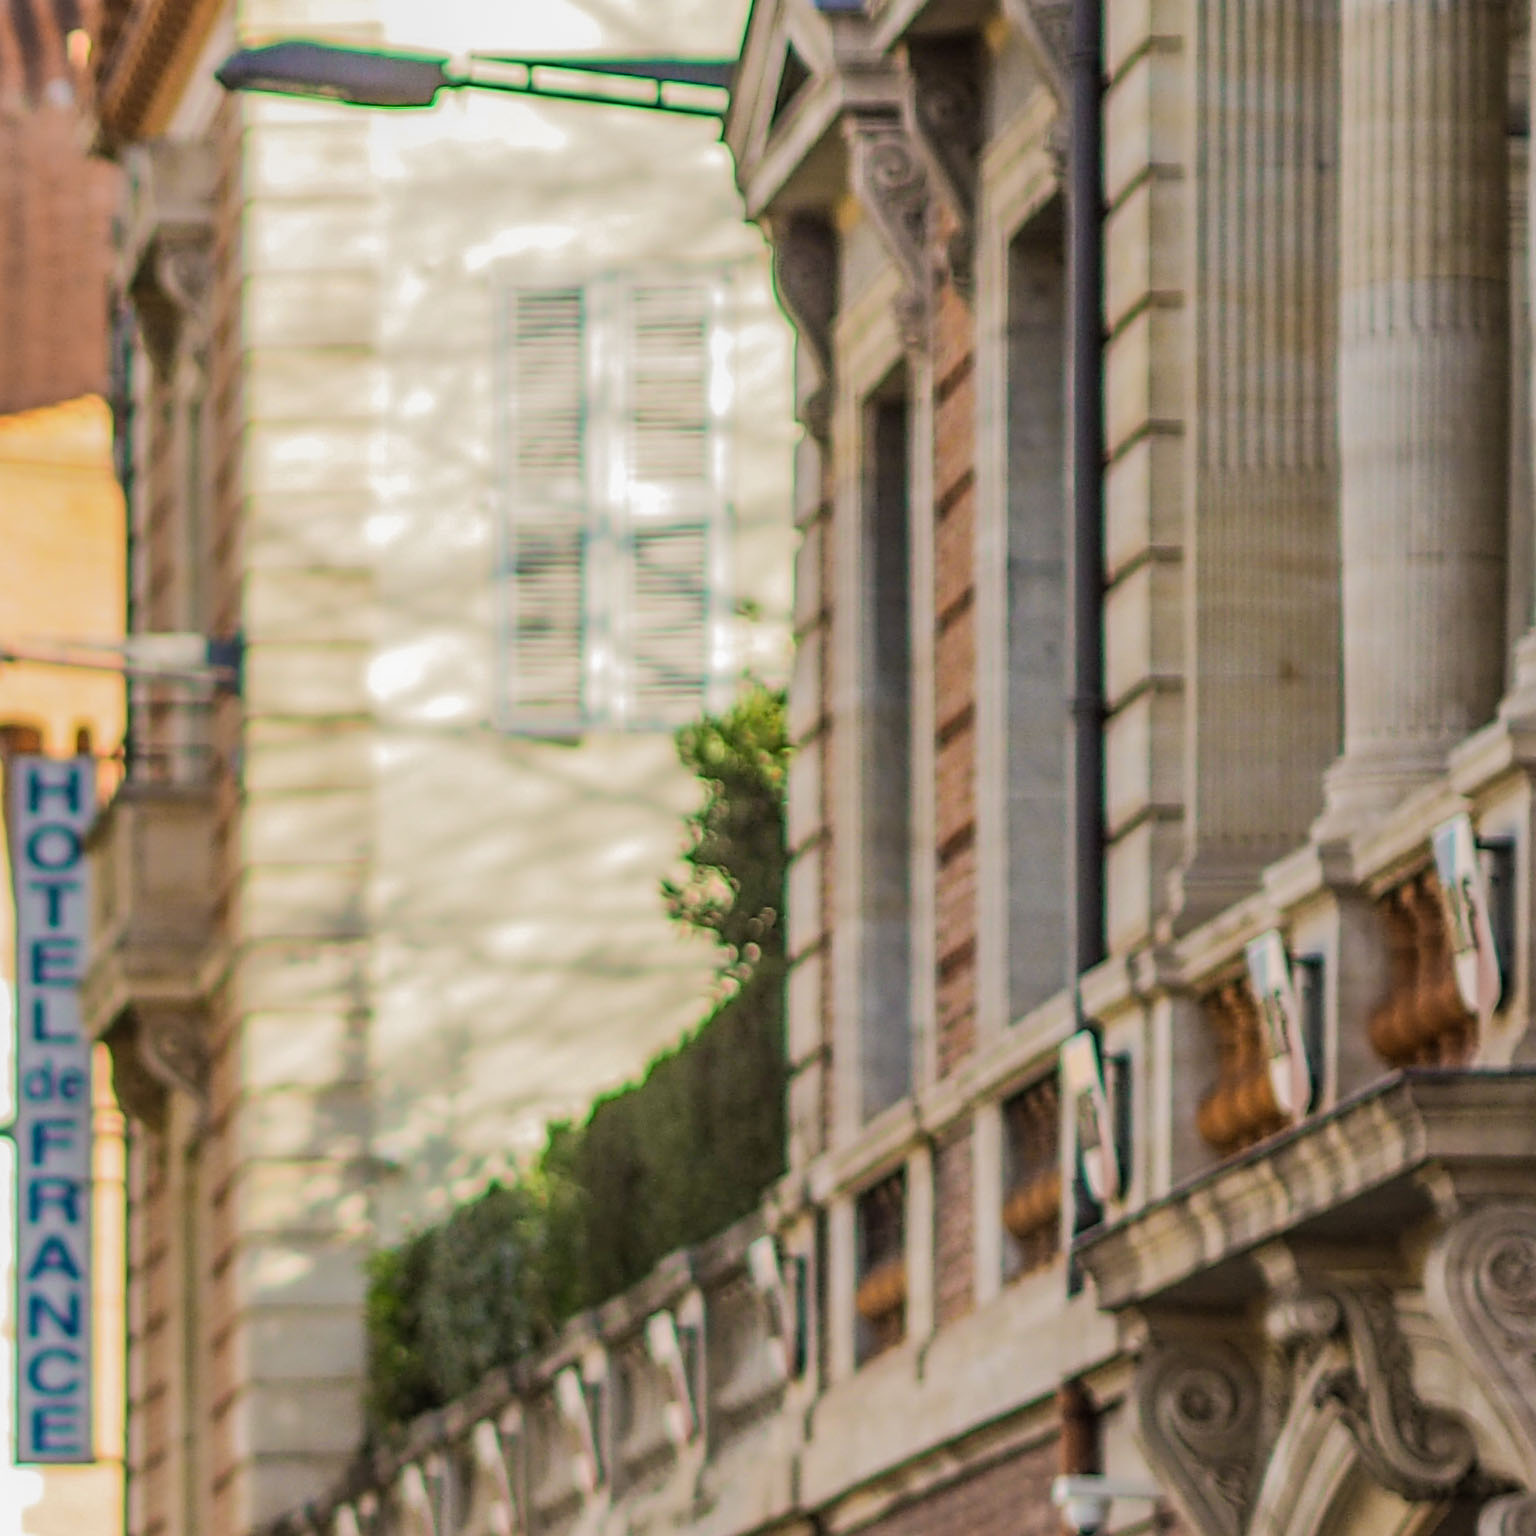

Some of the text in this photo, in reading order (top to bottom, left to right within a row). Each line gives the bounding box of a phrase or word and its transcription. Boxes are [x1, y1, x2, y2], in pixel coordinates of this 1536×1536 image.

[23, 767, 86, 1454] HOTEL de FRANCE
